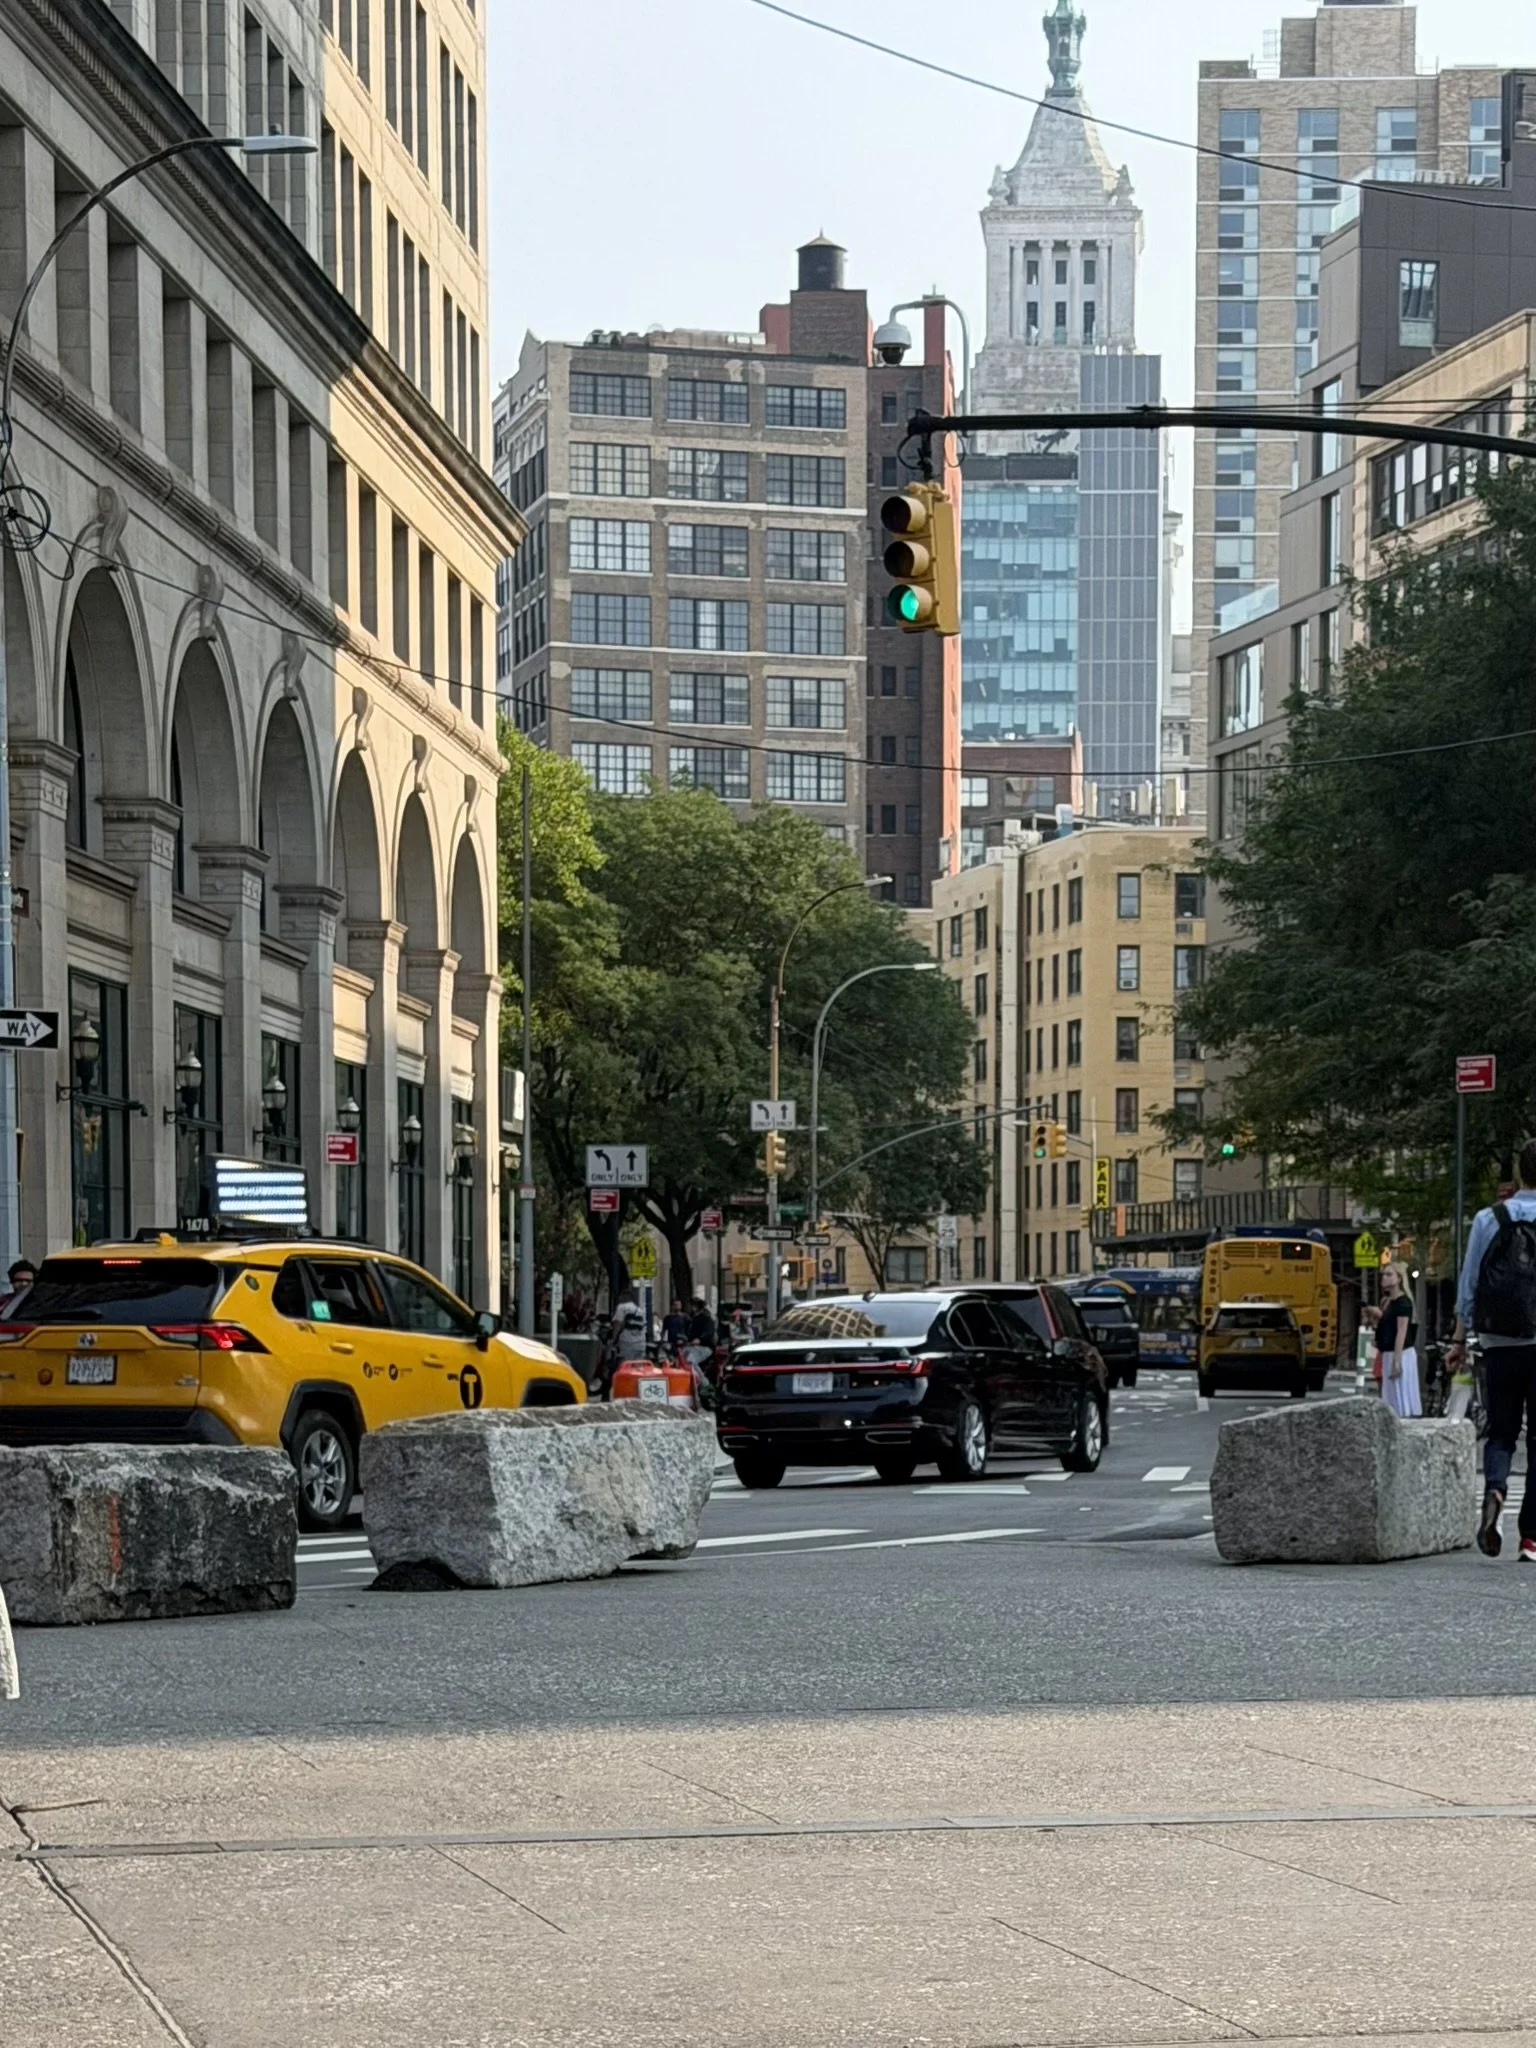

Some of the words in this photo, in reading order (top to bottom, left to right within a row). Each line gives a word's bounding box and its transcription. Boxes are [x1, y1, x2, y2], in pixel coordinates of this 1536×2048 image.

[7, 1021, 42, 1037] WAY
[591, 1173, 614, 1181] ONLY
[620, 1173, 644, 1181] ONLY
[1096, 1160, 1107, 1206] PARK
